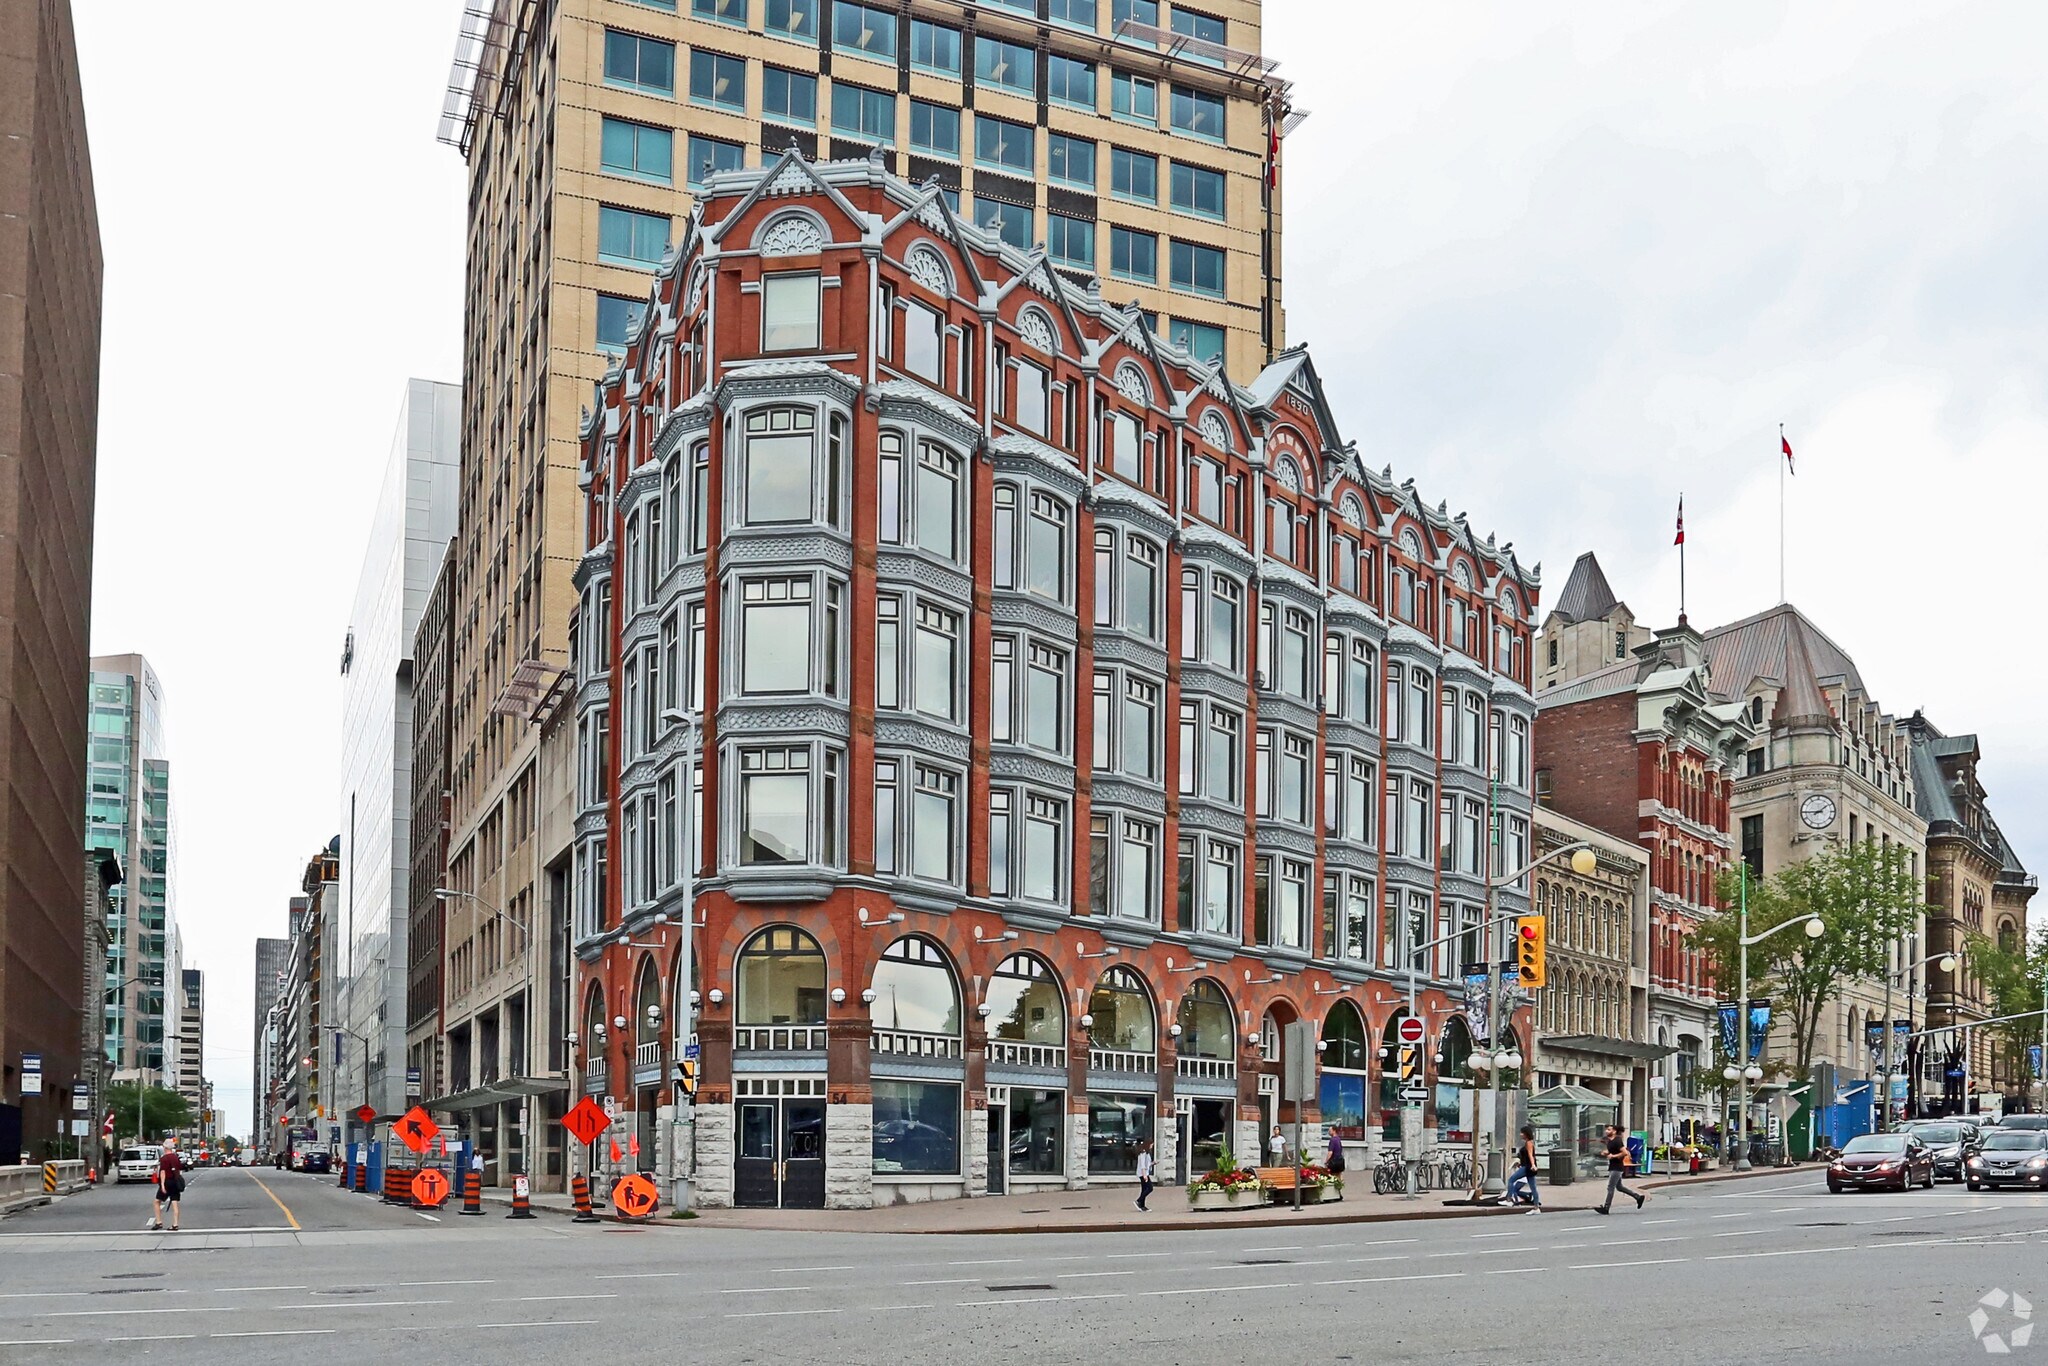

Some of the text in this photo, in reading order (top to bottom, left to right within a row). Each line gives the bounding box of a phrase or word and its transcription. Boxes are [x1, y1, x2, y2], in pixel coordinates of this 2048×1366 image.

[1285, 394, 1309, 416] 1890
[709, 1093, 724, 1104] 54
[832, 1093, 847, 1105] 54
